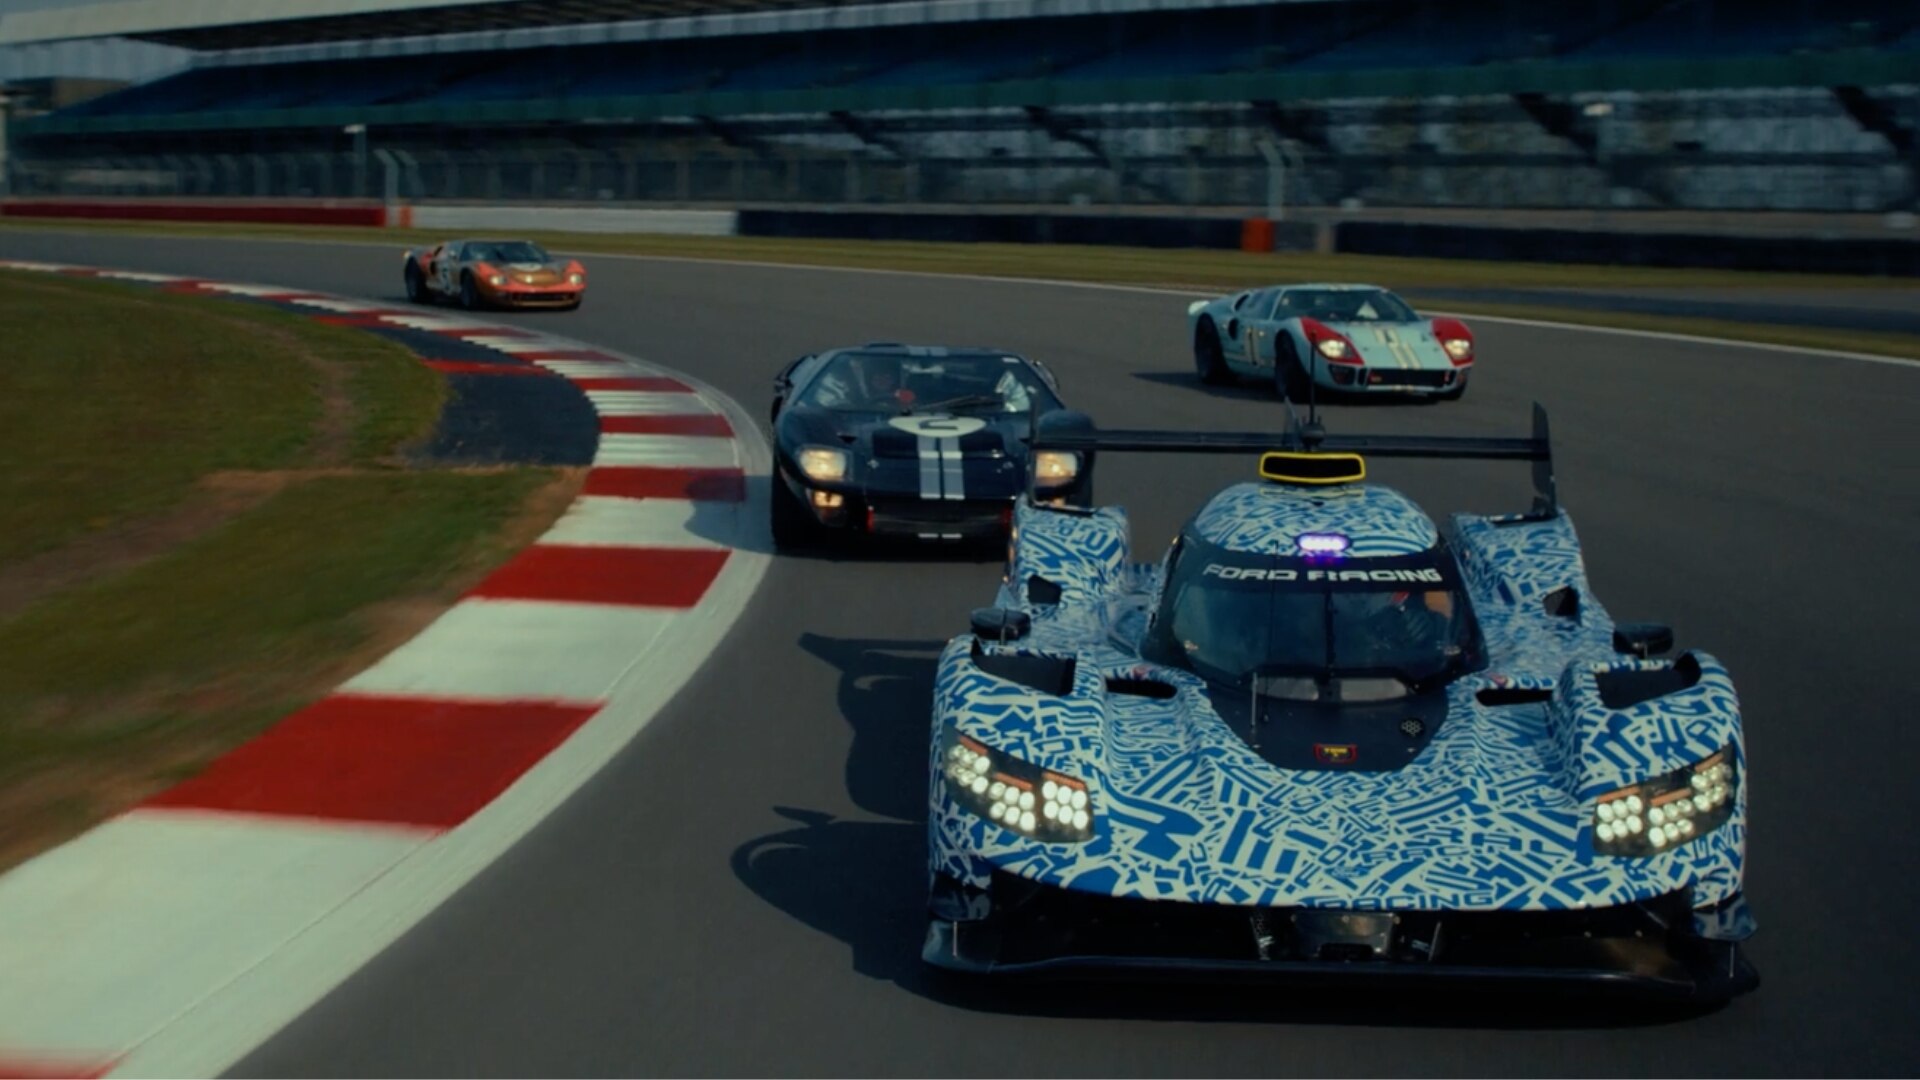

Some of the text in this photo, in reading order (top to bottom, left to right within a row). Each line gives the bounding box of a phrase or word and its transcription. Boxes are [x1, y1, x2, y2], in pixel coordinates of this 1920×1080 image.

[917, 413, 958, 429] 2
[1202, 563, 1443, 583] FORD RACING
